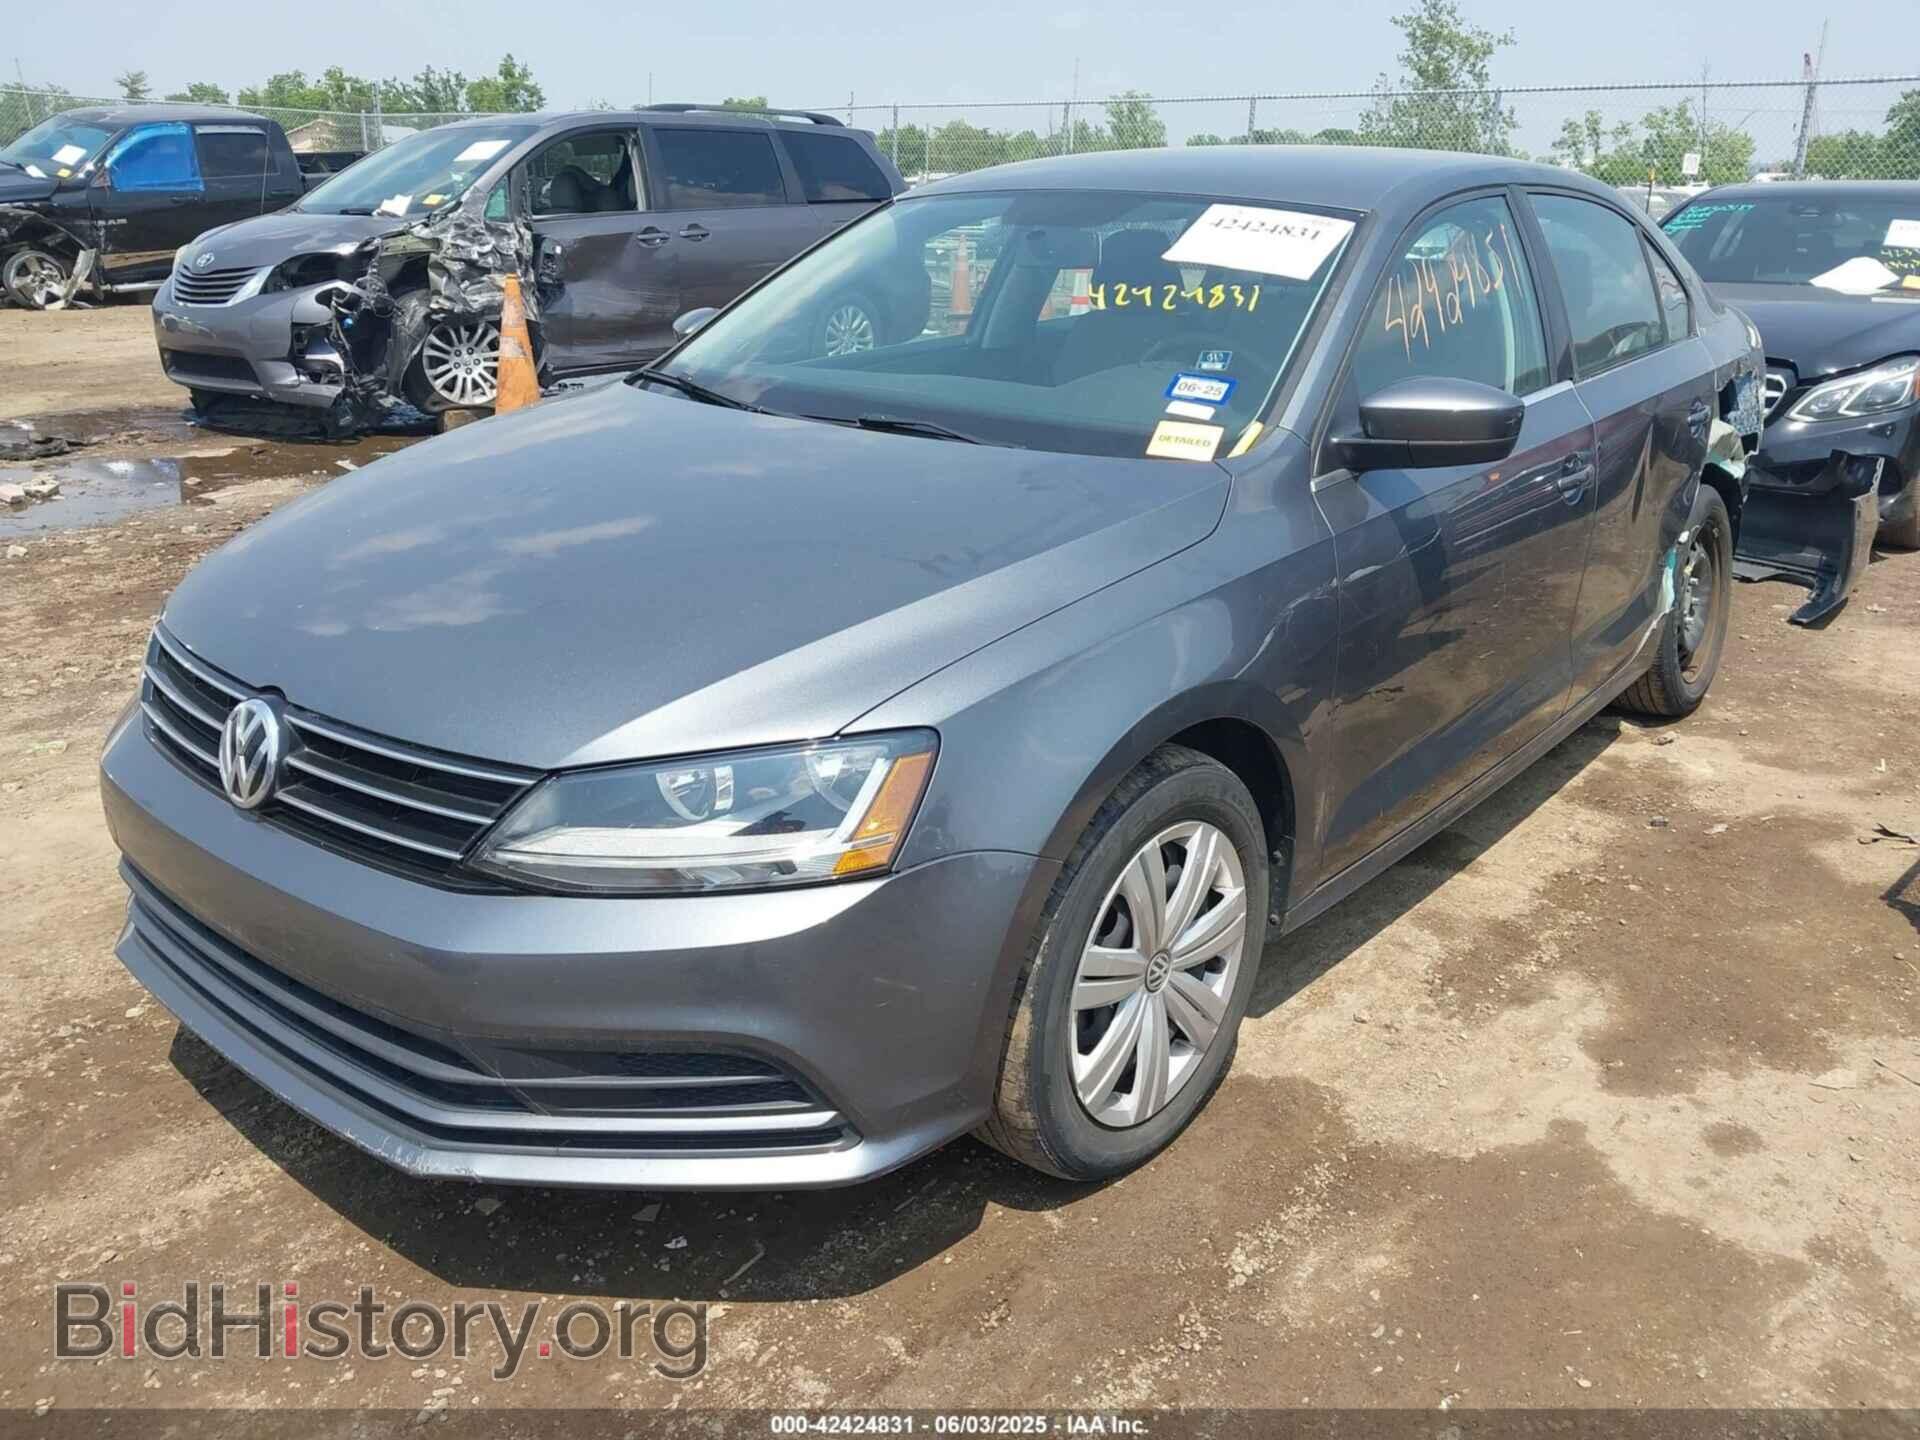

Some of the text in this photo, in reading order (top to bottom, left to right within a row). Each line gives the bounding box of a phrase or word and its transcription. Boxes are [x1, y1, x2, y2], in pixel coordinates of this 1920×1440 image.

[1210, 217, 1321, 241] 42424831
[1087, 283, 1261, 312] 42424831
[1177, 380, 1223, 397] 06-25
[1158, 434, 1212, 448] DETAILED
